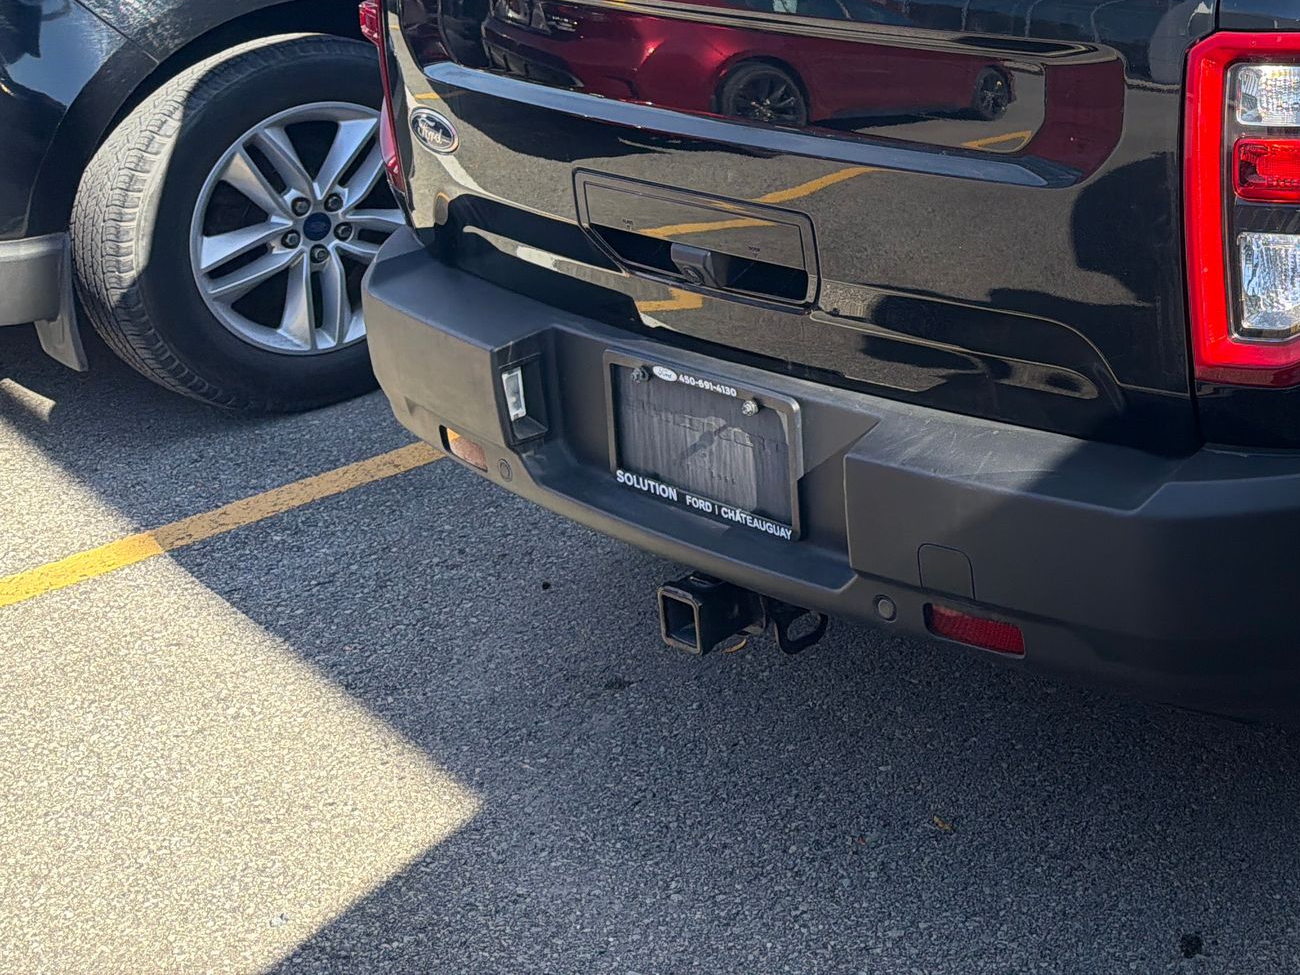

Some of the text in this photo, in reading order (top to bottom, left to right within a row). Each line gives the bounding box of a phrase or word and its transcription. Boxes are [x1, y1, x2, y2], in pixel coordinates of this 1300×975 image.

[679, 374, 737, 397] 450-691-4130
[616, 470, 677, 501] SOLUTION
[686, 495, 712, 515] FORD
[721, 506, 792, 540] CHÂTEAUGUAY
